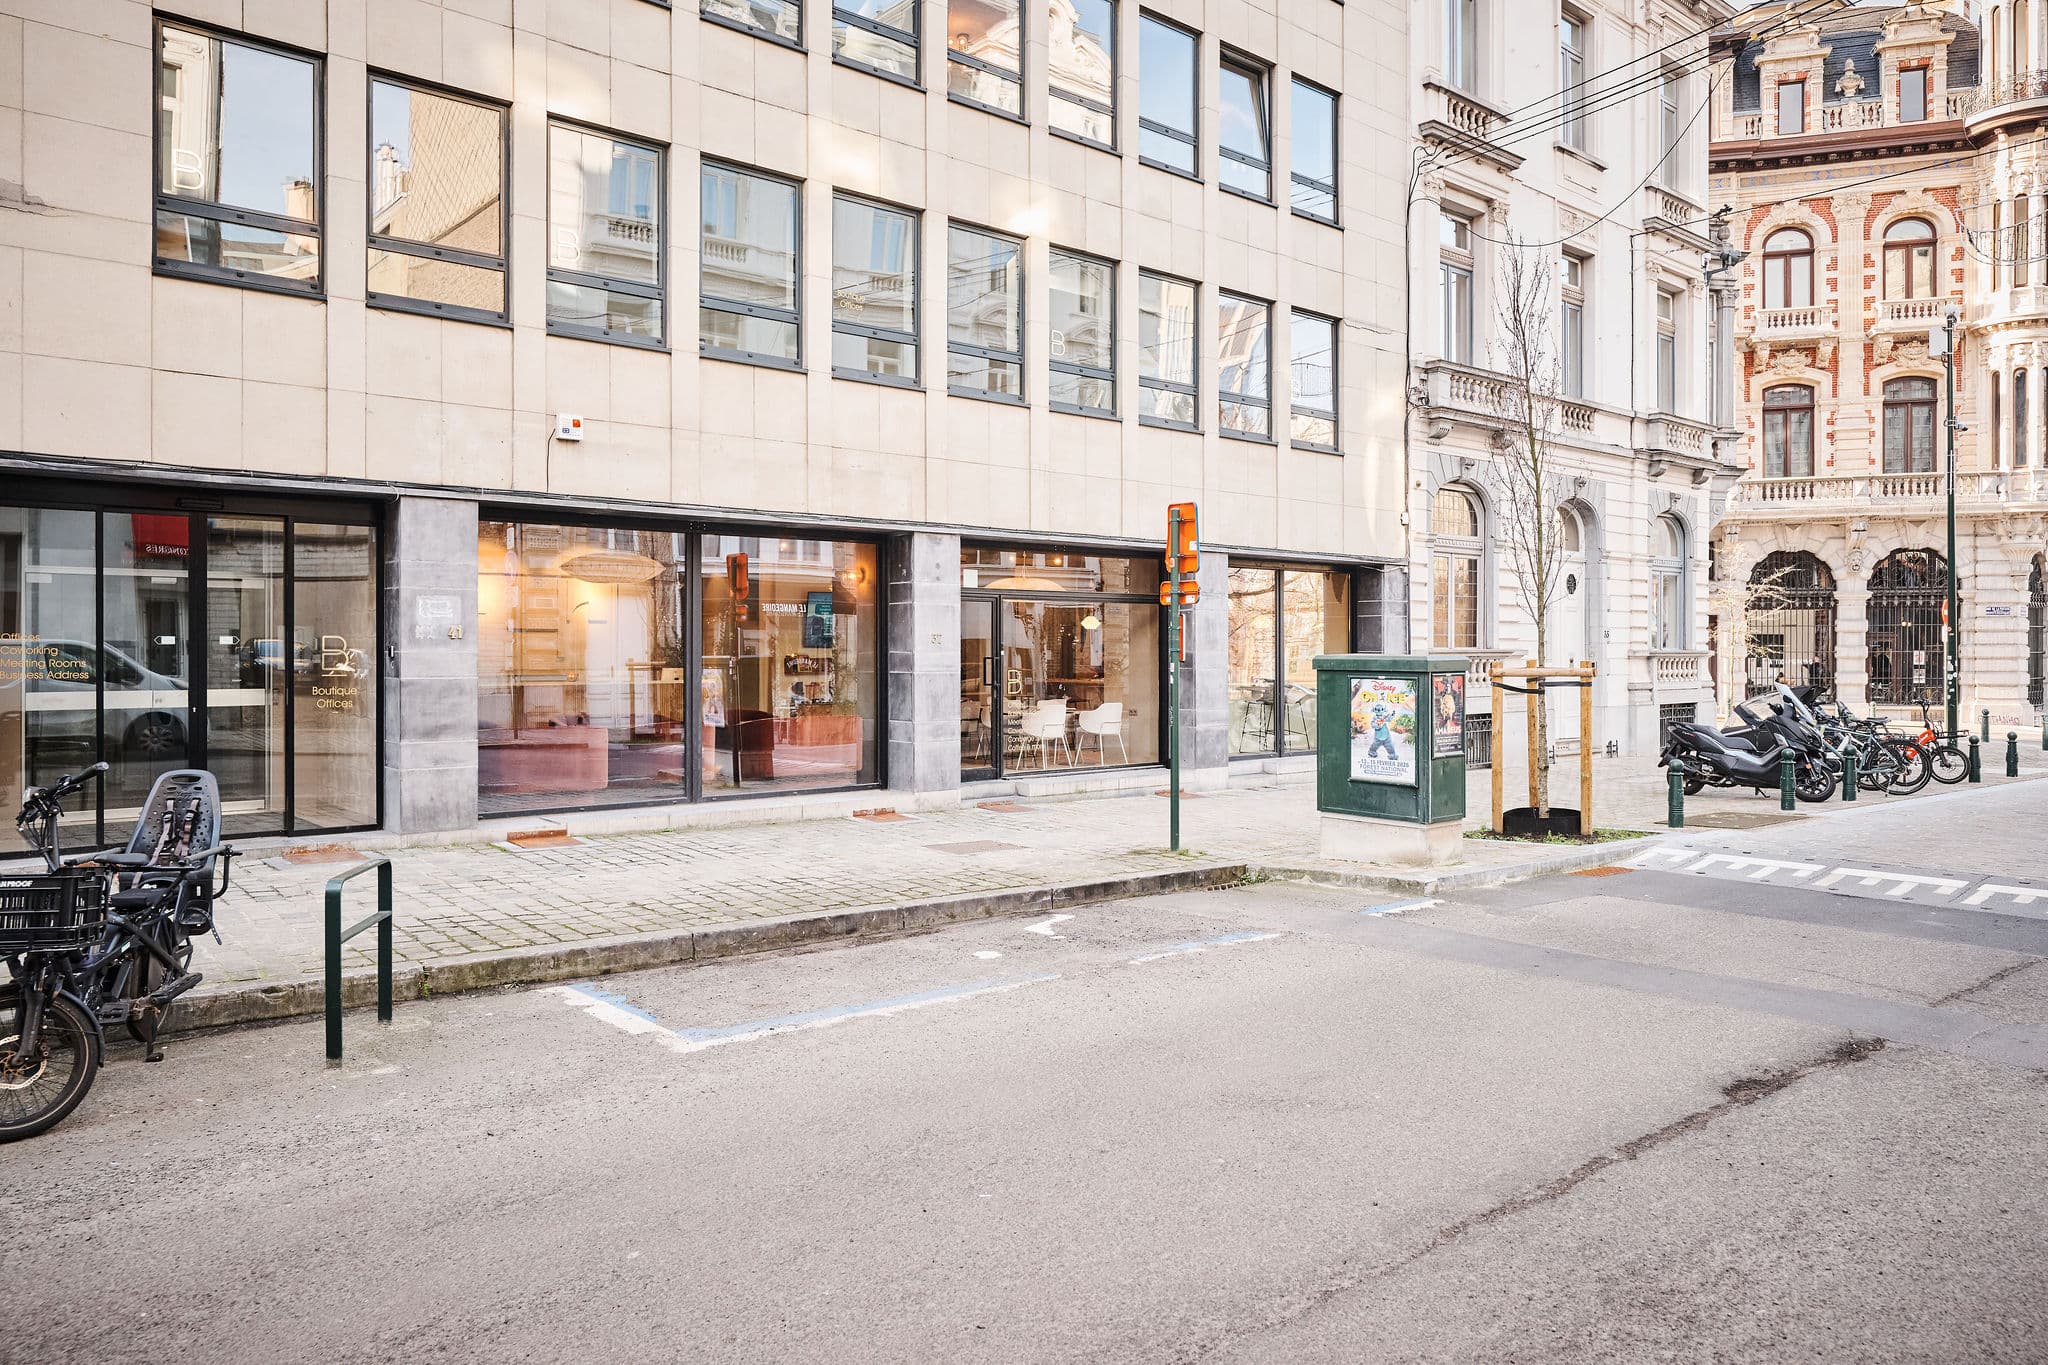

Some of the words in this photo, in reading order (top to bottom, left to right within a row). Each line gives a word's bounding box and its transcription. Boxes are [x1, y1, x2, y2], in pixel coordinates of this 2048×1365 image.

[448, 625, 464, 640] 41
[0, 645, 58, 656] Coworking
[0, 659, 46, 669] Meeting
[49, 659, 87, 668] Rooms
[47, 670, 89, 679] Address
[312, 686, 357, 696] Boutique
[1371, 681, 1396, 693] Disney
[316, 699, 353, 708] Offices
